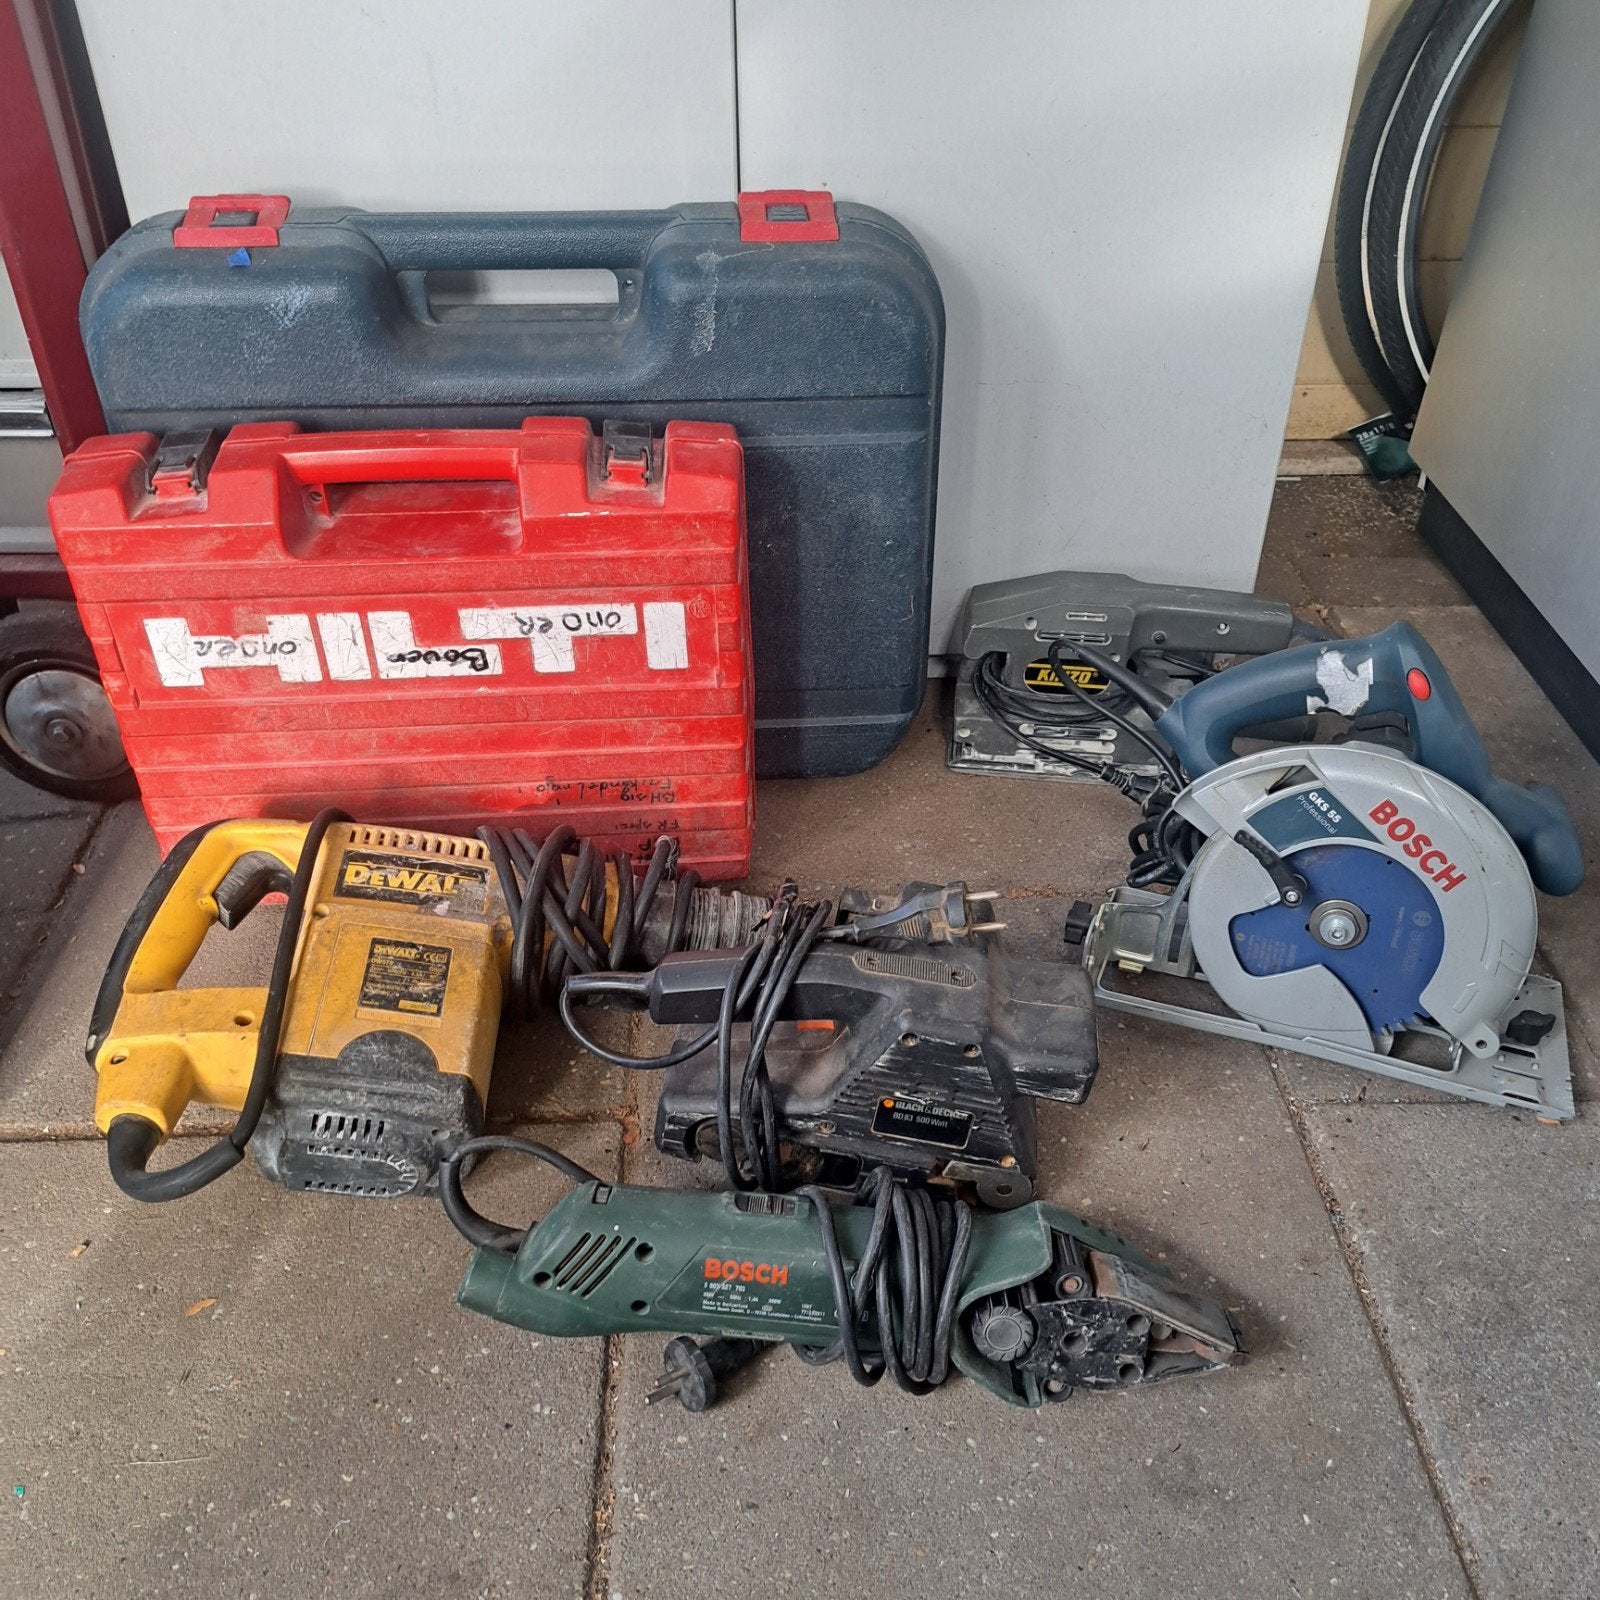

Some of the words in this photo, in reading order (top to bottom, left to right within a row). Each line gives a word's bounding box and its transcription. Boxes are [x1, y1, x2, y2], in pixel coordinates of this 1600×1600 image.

[143, 600, 689, 687] HILTI
[1296, 794, 1338, 834] Professional
[1308, 792, 1330, 811] GKS
[1327, 809, 1342, 823] 55
[1368, 798, 1467, 893] BOSCH
[916, 1116, 930, 1124] 500
[704, 1258, 789, 1285] BOSCH
